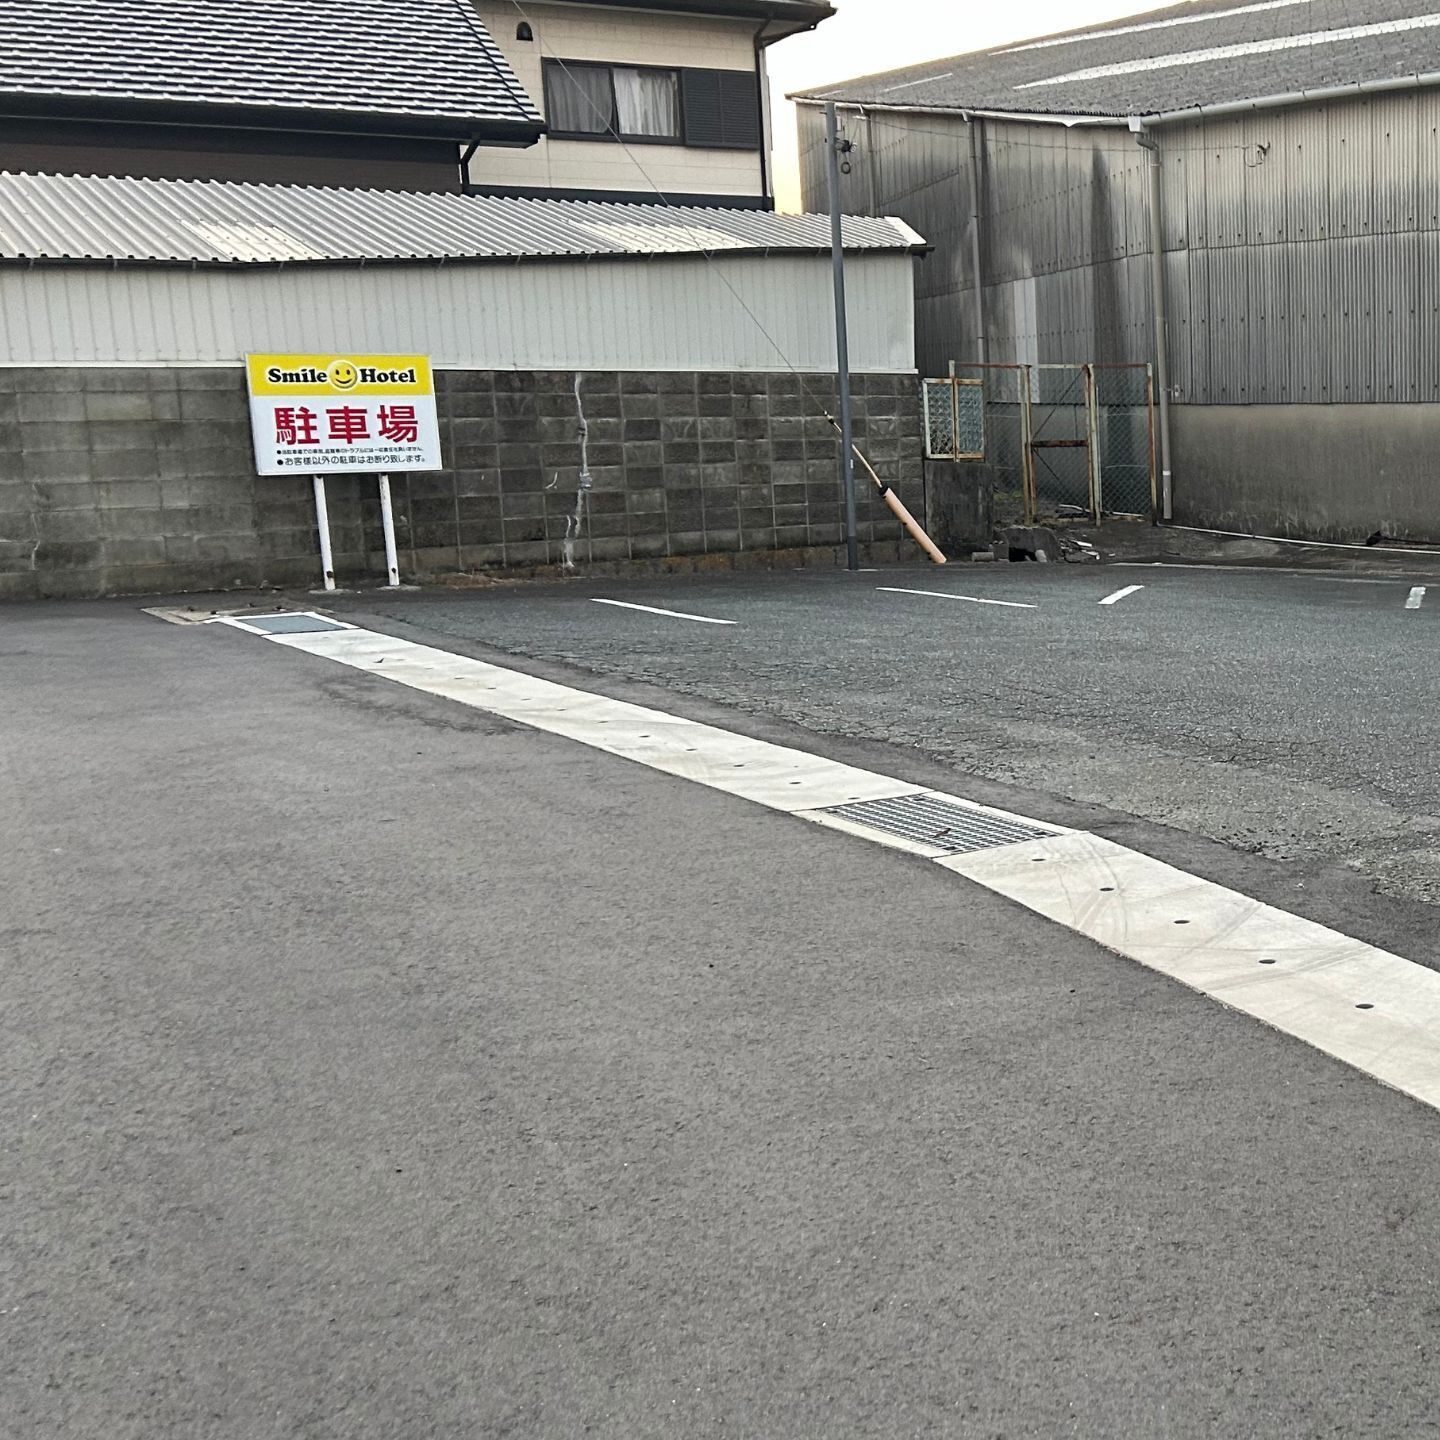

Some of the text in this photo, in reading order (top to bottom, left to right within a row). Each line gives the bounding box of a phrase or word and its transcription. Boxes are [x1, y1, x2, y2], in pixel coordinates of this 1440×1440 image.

[268, 368, 416, 383] Smile Hotel
[274, 405, 418, 445] 駐車場
